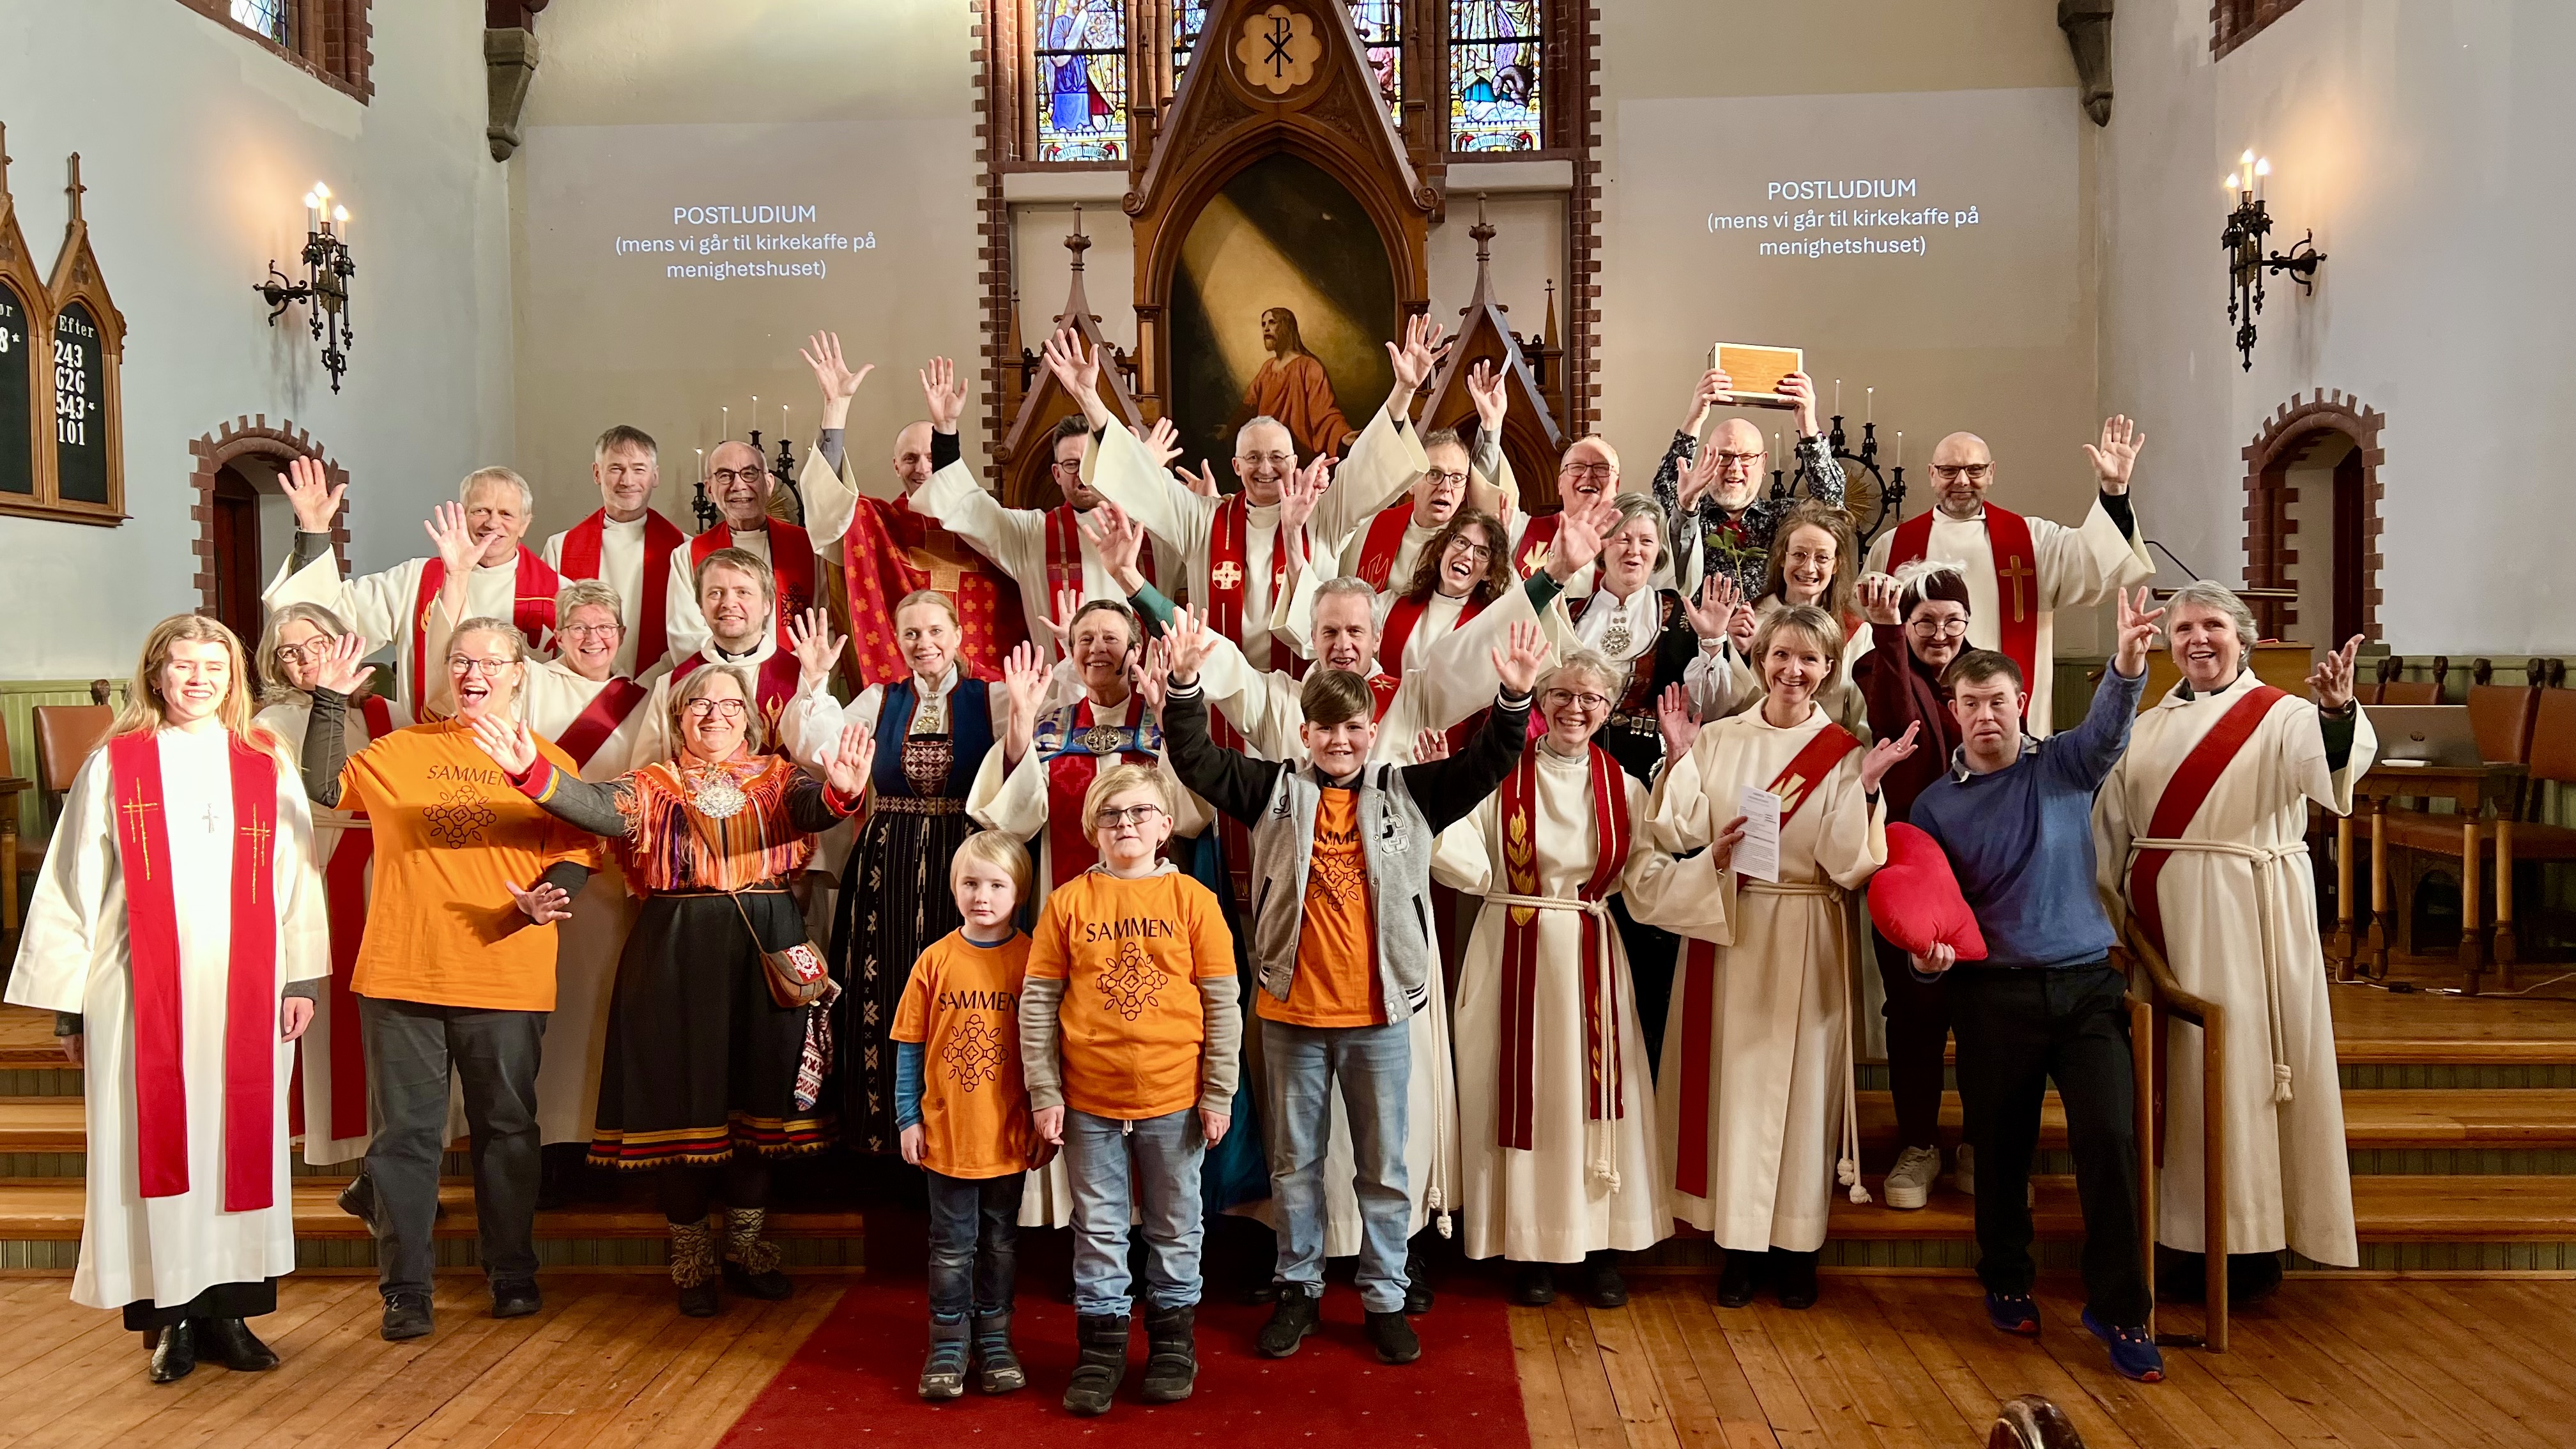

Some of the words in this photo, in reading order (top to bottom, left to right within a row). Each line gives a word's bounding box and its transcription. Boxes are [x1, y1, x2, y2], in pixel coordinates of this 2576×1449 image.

[1768, 178, 1917, 200] POSTLUDIUM
[673, 205, 816, 225] POSTLUDIUM
[1708, 213, 1768, 233] (mens
[1772, 211, 1788, 228] vi
[1793, 210, 1825, 231] går
[1829, 210, 1848, 227] til
[1853, 207, 1949, 227] kirkekaffe
[1954, 205, 1979, 227] på
[615, 236, 675, 256] (mens
[678, 235, 694, 251] vi
[699, 233, 729, 255] går
[733, 234, 751, 251] til
[756, 233, 848, 250] kirkekaffe
[854, 231, 876, 252] på
[1759, 235, 1926, 259] menighetshuset)
[666, 259, 827, 281] menighetshuset)
[58, 314, 95, 338] Efter
[54, 340, 83, 368] 243
[56, 366, 85, 394] 626
[56, 390, 85, 420] 543
[57, 418, 85, 446] 101
[427, 765, 510, 788] SAMMEN
[1086, 917, 1173, 942] SAMMEN
[938, 990, 1020, 1012] SAMMEN
